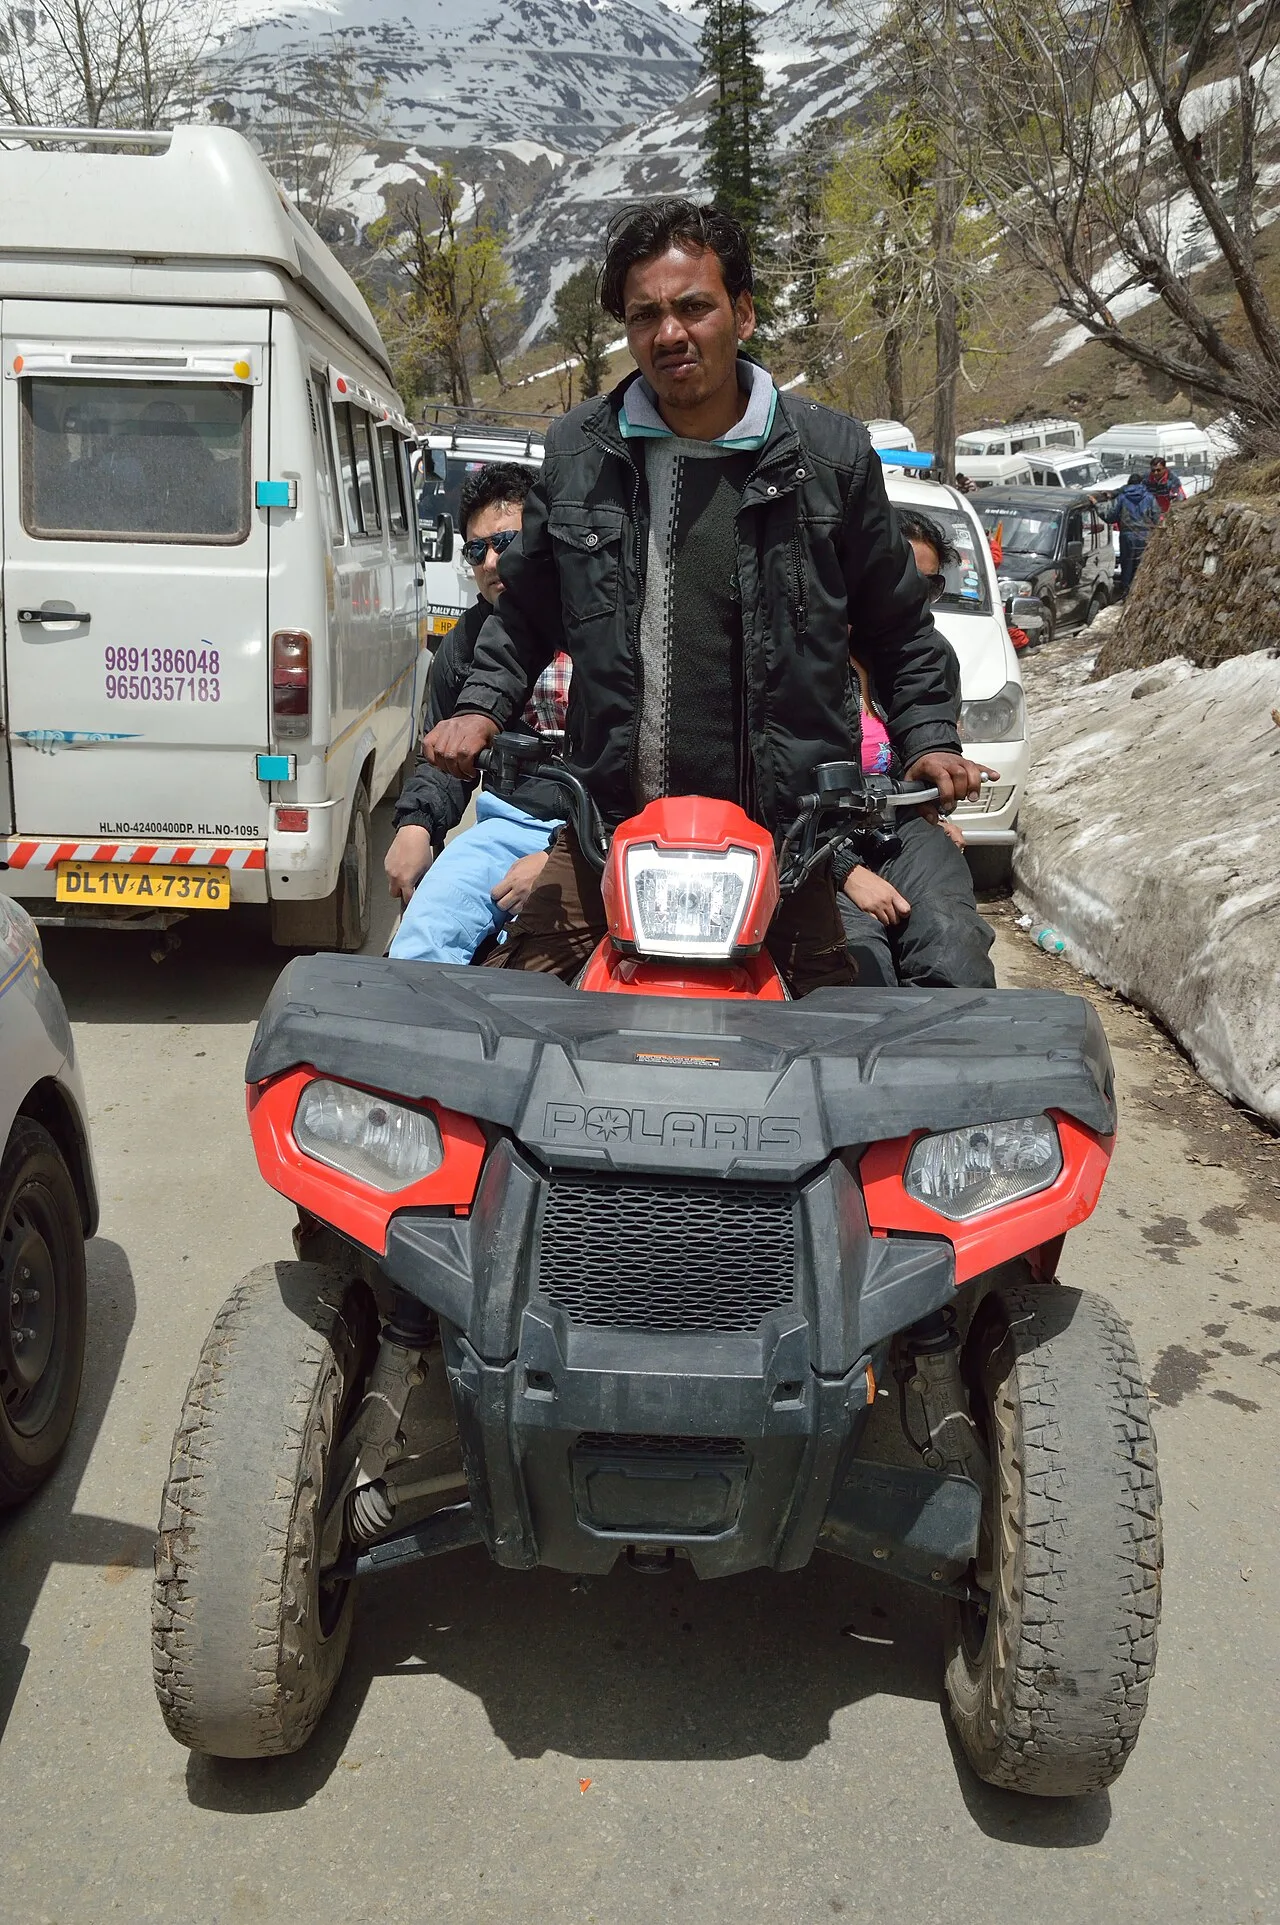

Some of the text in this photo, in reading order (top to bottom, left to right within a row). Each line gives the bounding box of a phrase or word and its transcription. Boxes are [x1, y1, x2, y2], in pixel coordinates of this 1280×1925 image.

[431, 606, 450, 615] RALLY
[105, 646, 220, 675] 9891386048
[105, 674, 221, 702] 9650357183
[198, 824, 259, 836] HL.NO-1095
[66, 871, 221, 900] DL1V A 7376
[544, 1102, 801, 1153] POLARIS
